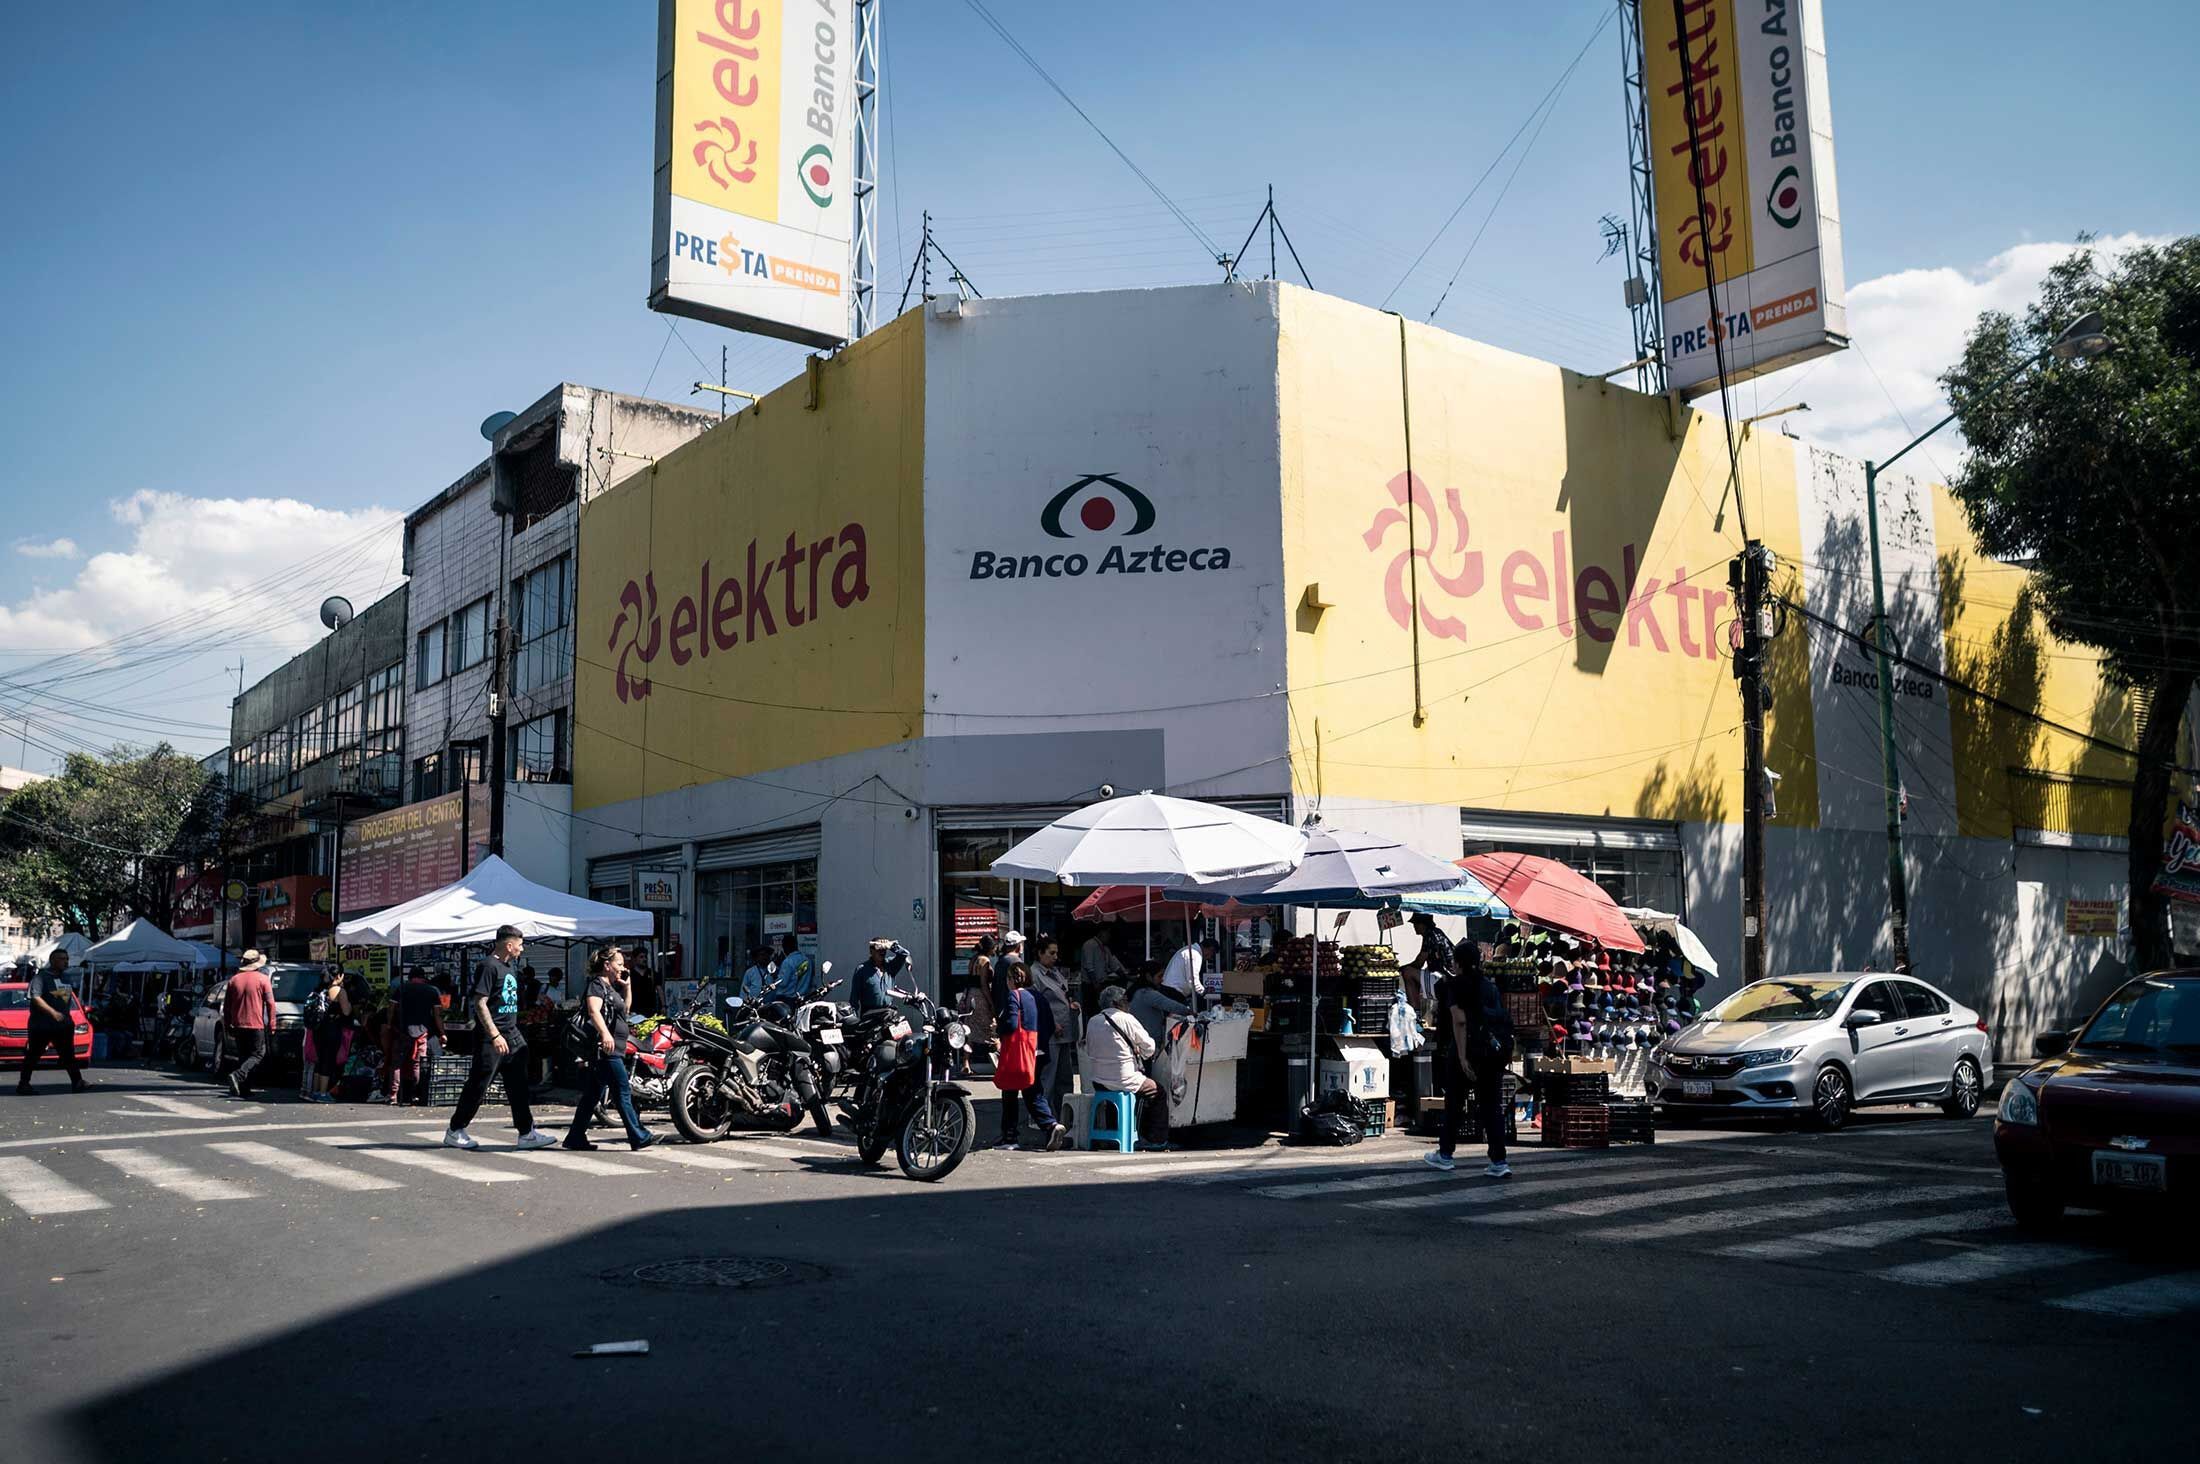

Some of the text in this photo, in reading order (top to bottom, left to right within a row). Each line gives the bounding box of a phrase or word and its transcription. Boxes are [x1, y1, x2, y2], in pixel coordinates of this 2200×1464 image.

[806, 21, 836, 139] Banco
[1768, 47, 1798, 159] Banco
[674, 230, 838, 291] PRE$TA PRENDA
[1754, 296, 1815, 325] PRENDA
[969, 544, 1232, 580] Banco Azteca
[669, 522, 870, 667] elektra
[1832, 662, 1934, 699] Banco zteca
[407, 808, 424, 830] DEL
[426, 798, 464, 826] CENTRO
[345, 949, 369, 961] ORO
